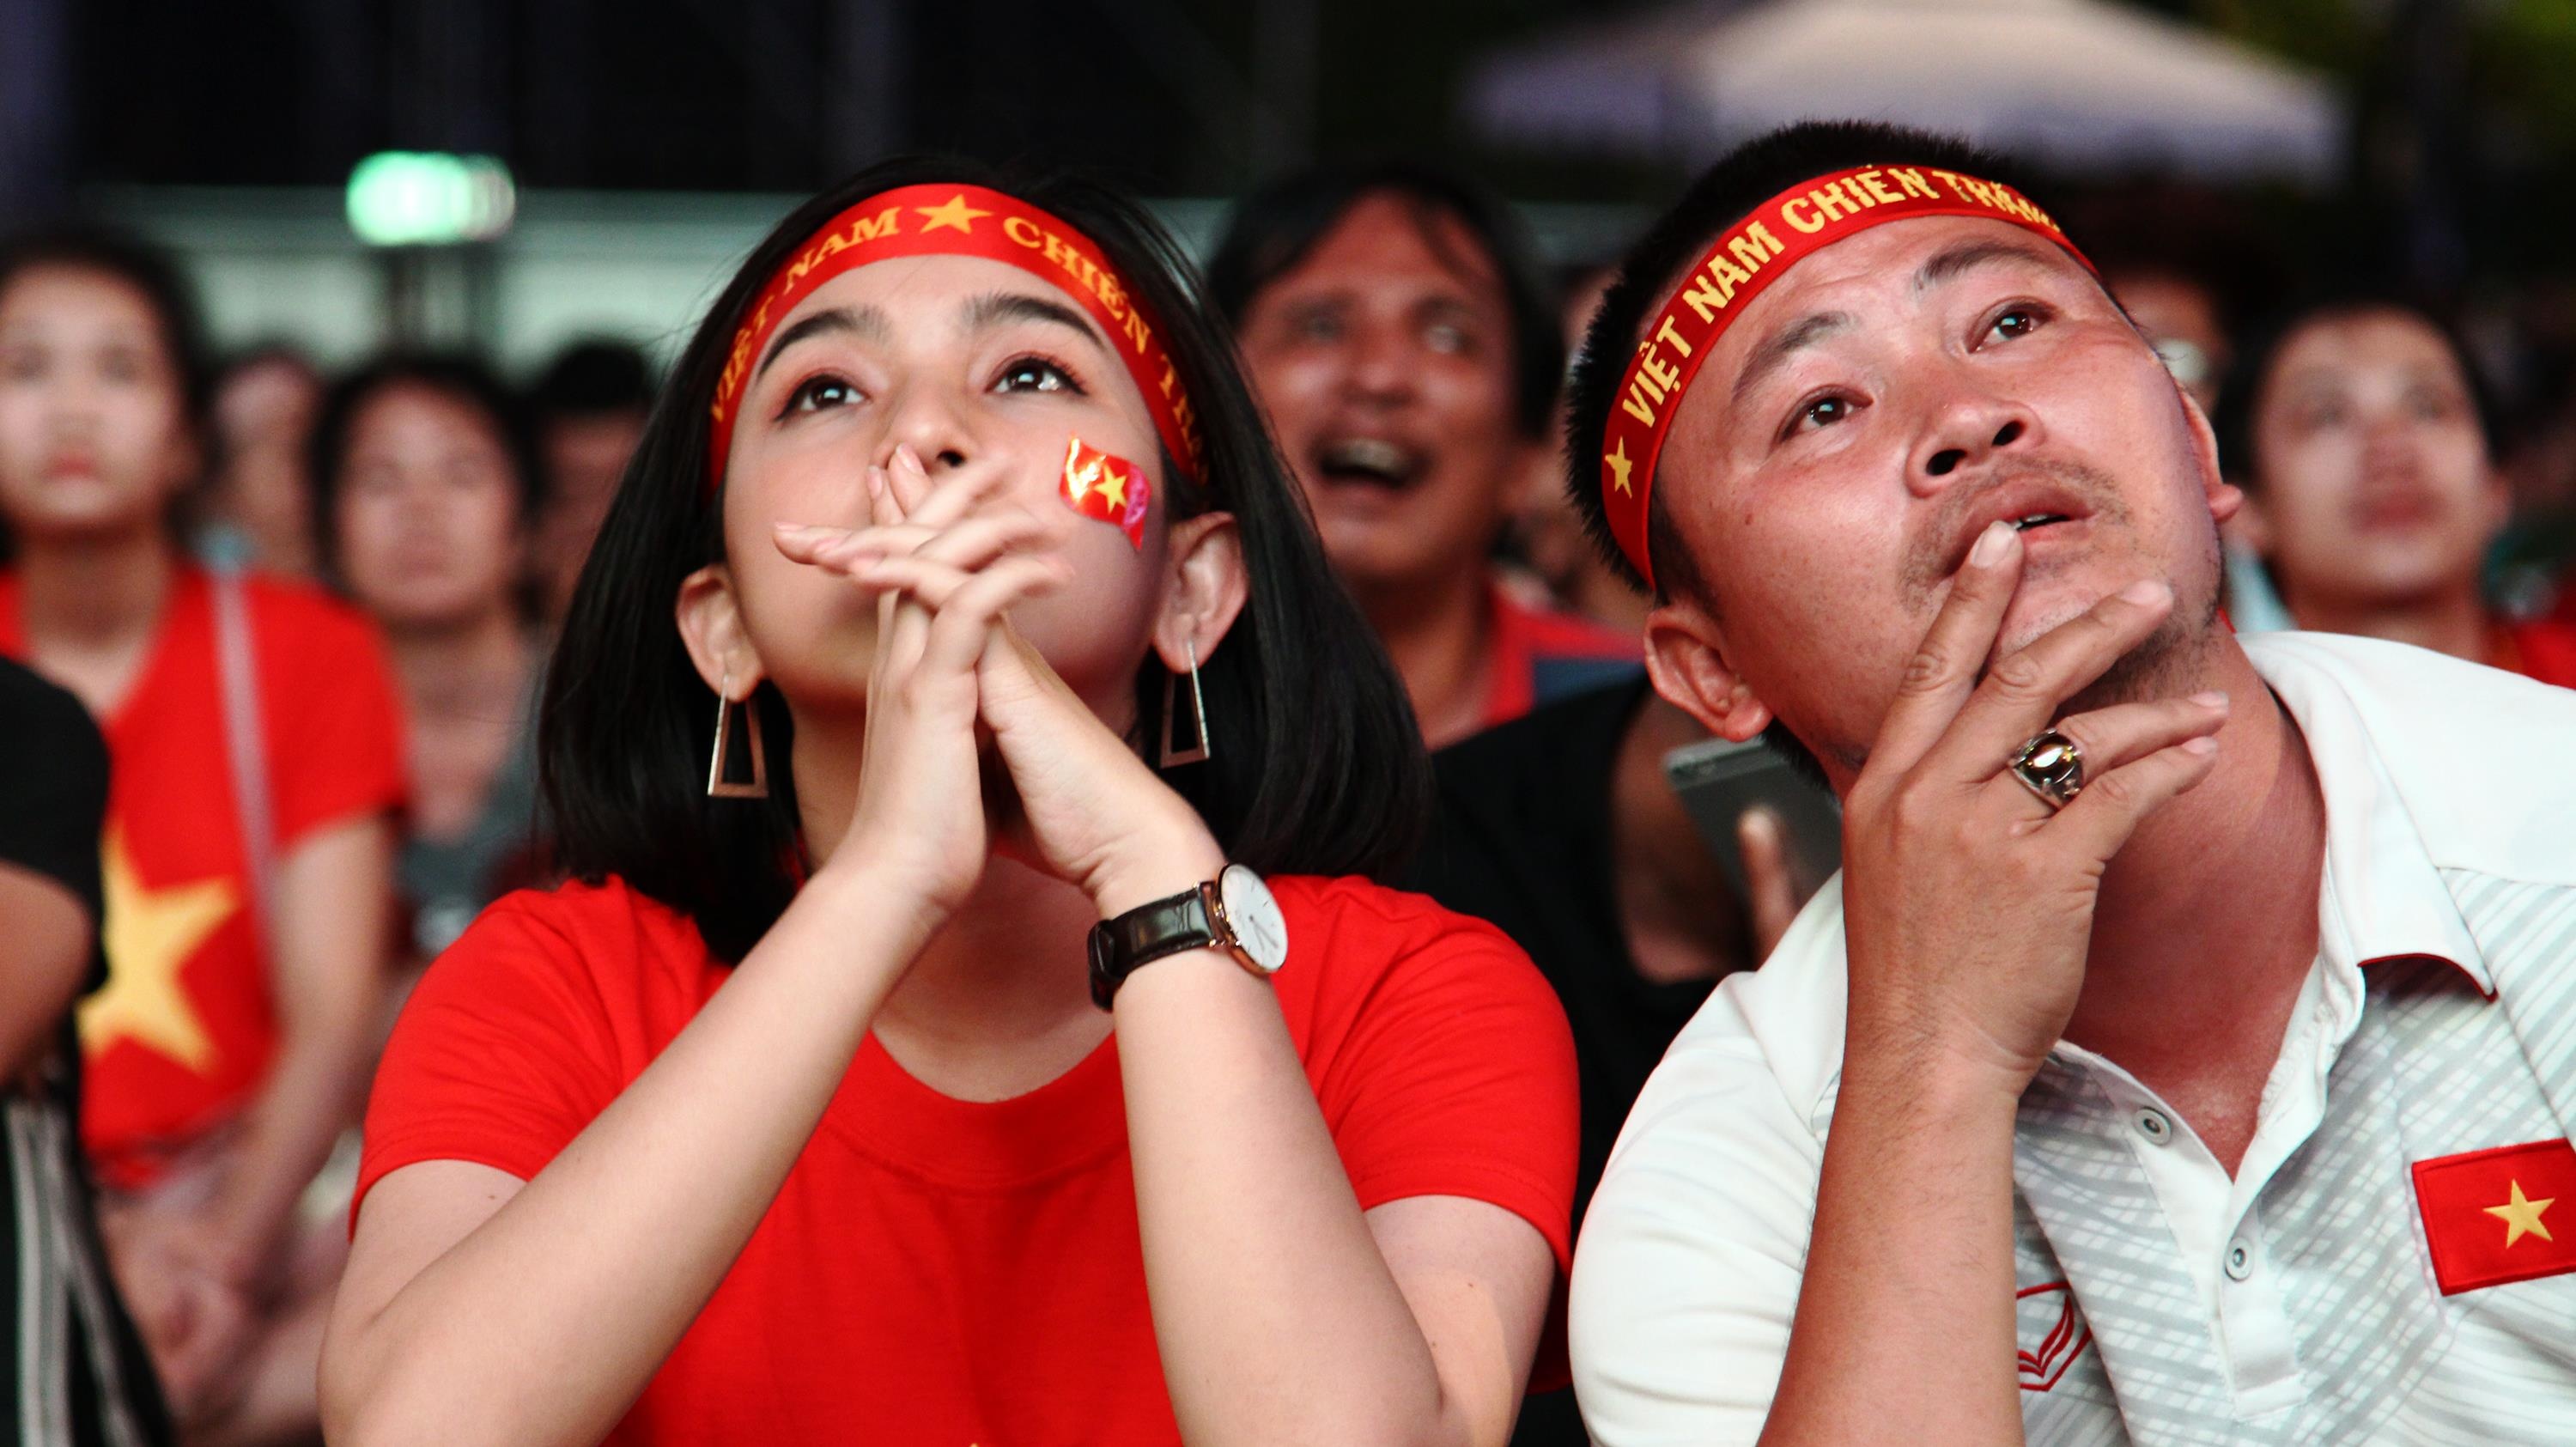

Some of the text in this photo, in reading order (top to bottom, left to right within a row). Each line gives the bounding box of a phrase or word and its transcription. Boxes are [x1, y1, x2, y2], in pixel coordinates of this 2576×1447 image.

[783, 206, 901, 295] NAM
[1622, 314, 1692, 428] VIỆT
[1682, 220, 1785, 325] NAM
